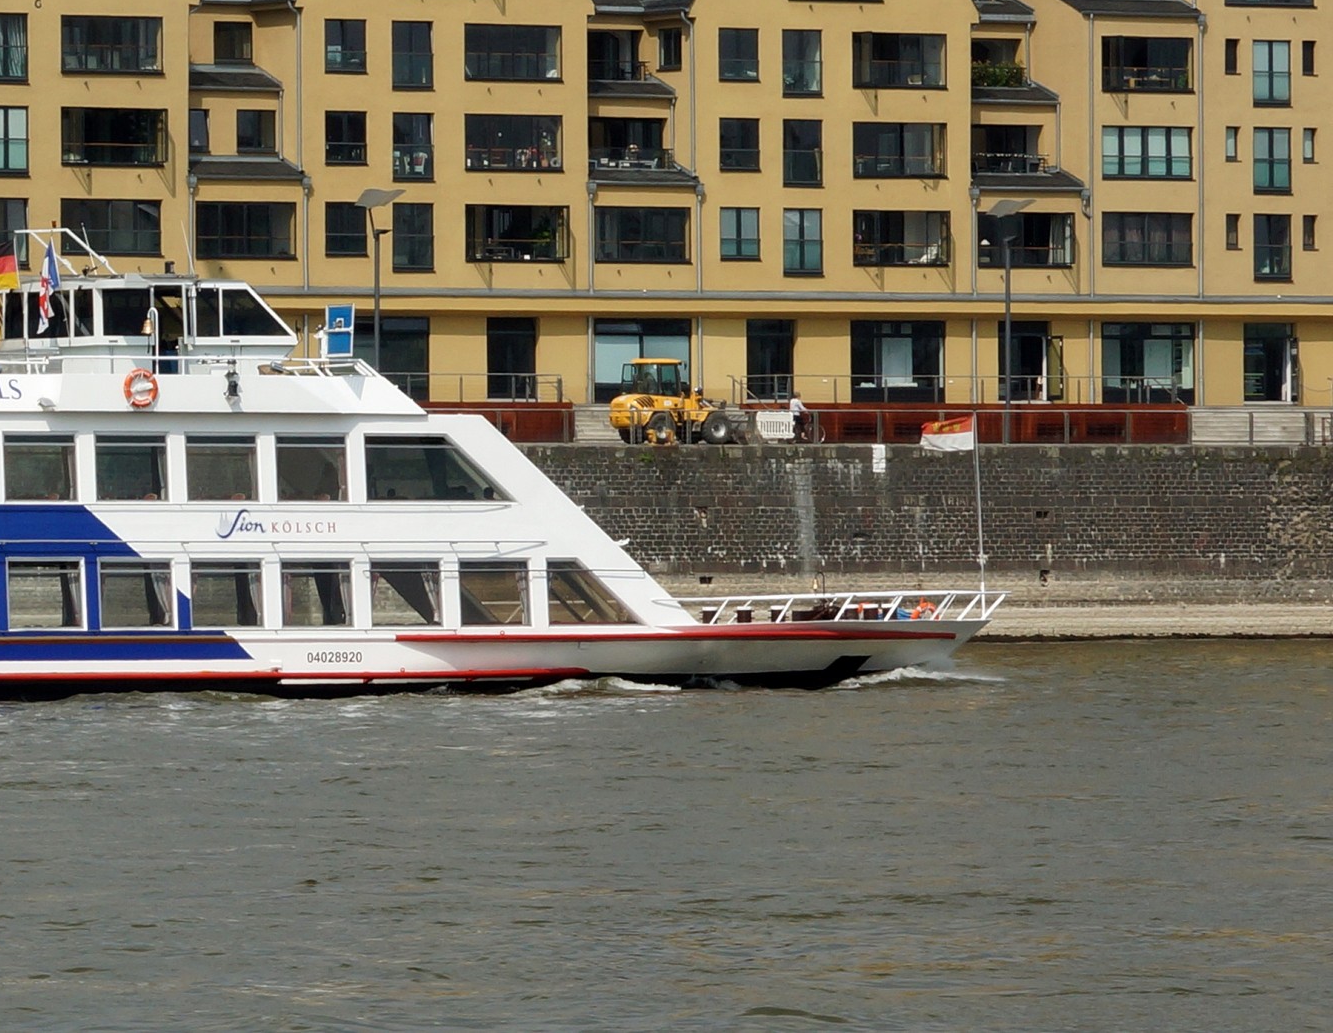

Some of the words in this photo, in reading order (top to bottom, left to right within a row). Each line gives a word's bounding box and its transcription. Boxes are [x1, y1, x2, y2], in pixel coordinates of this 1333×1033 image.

[215, 509, 267, 539] Sion
[271, 520, 337, 534] KÖLSCH
[307, 651, 363, 663] 04028920
